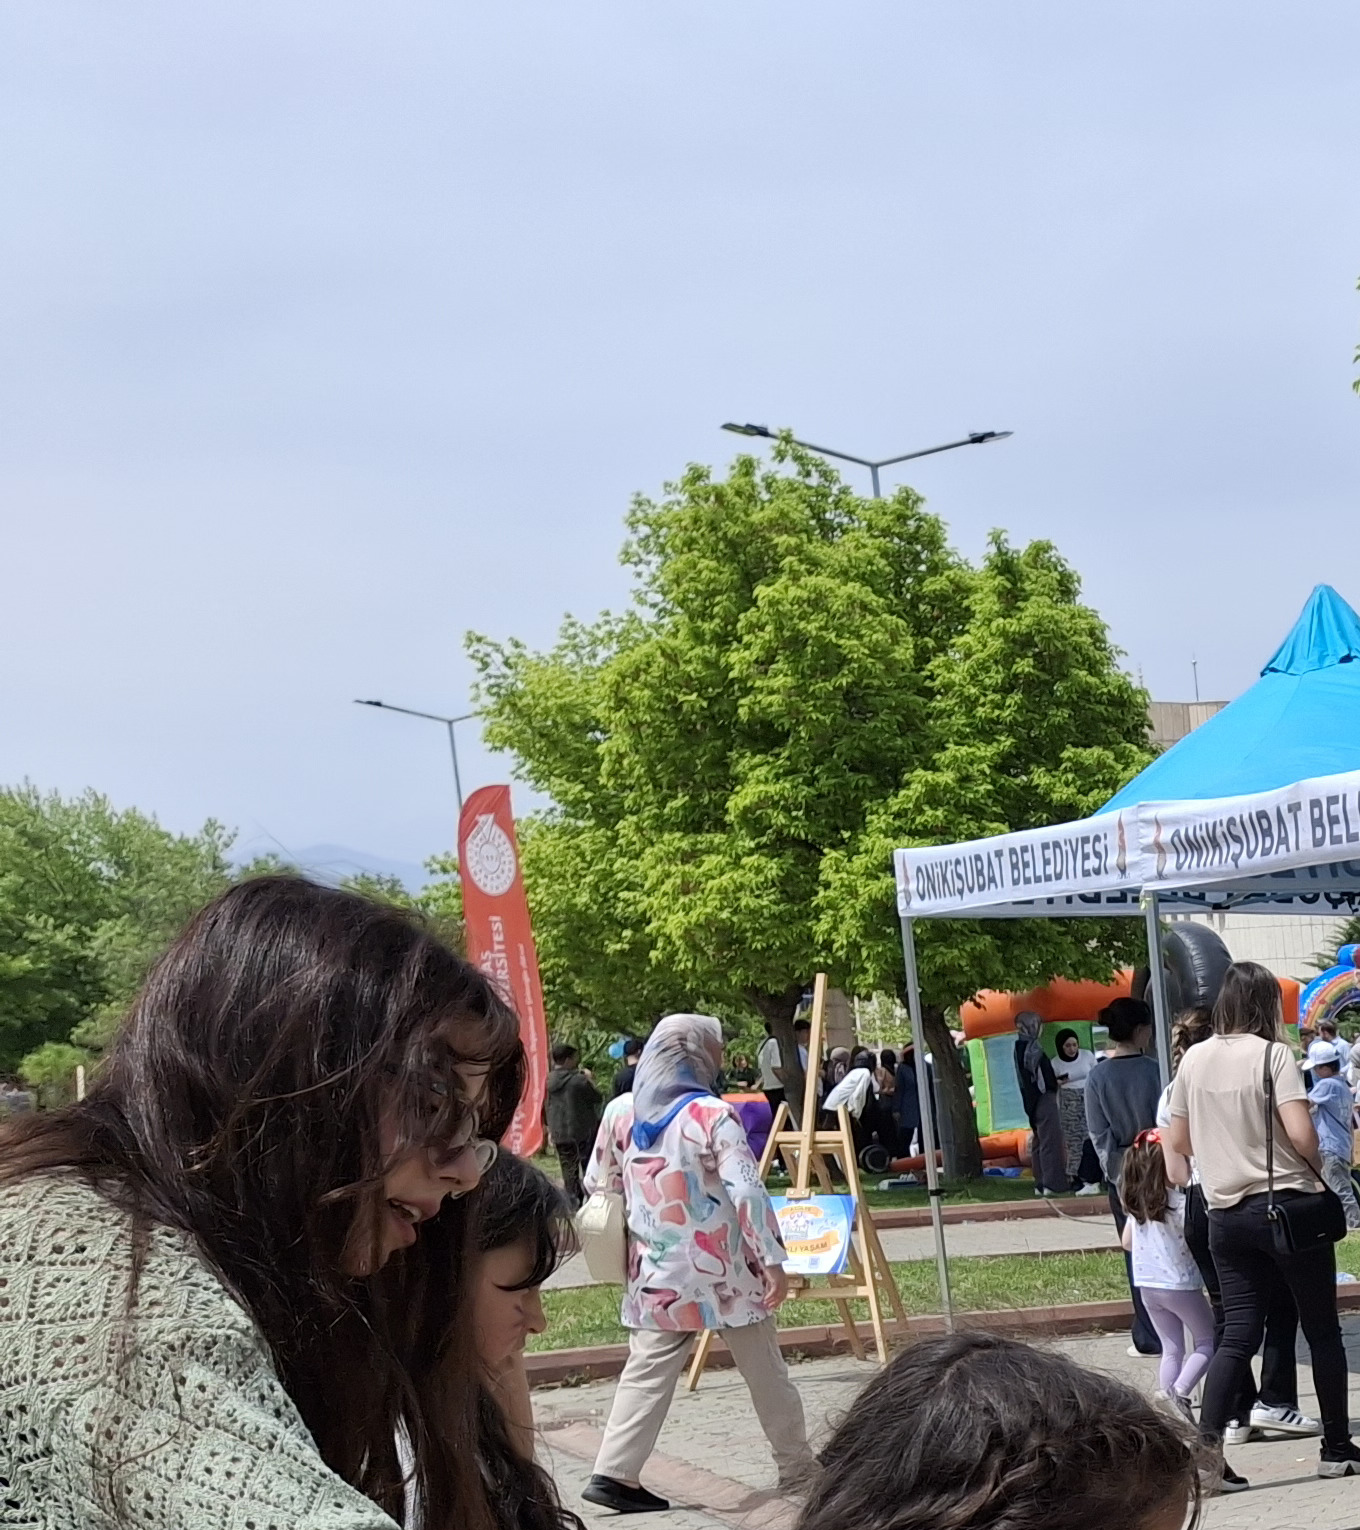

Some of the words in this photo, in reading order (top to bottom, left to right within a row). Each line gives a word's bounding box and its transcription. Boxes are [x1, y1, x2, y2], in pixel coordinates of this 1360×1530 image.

[915, 849, 1005, 901] ONİKİŞUBAT
[1009, 832, 1110, 887] BELEDİYESİ
[1170, 803, 1302, 872] ONİKİŞUBAT
